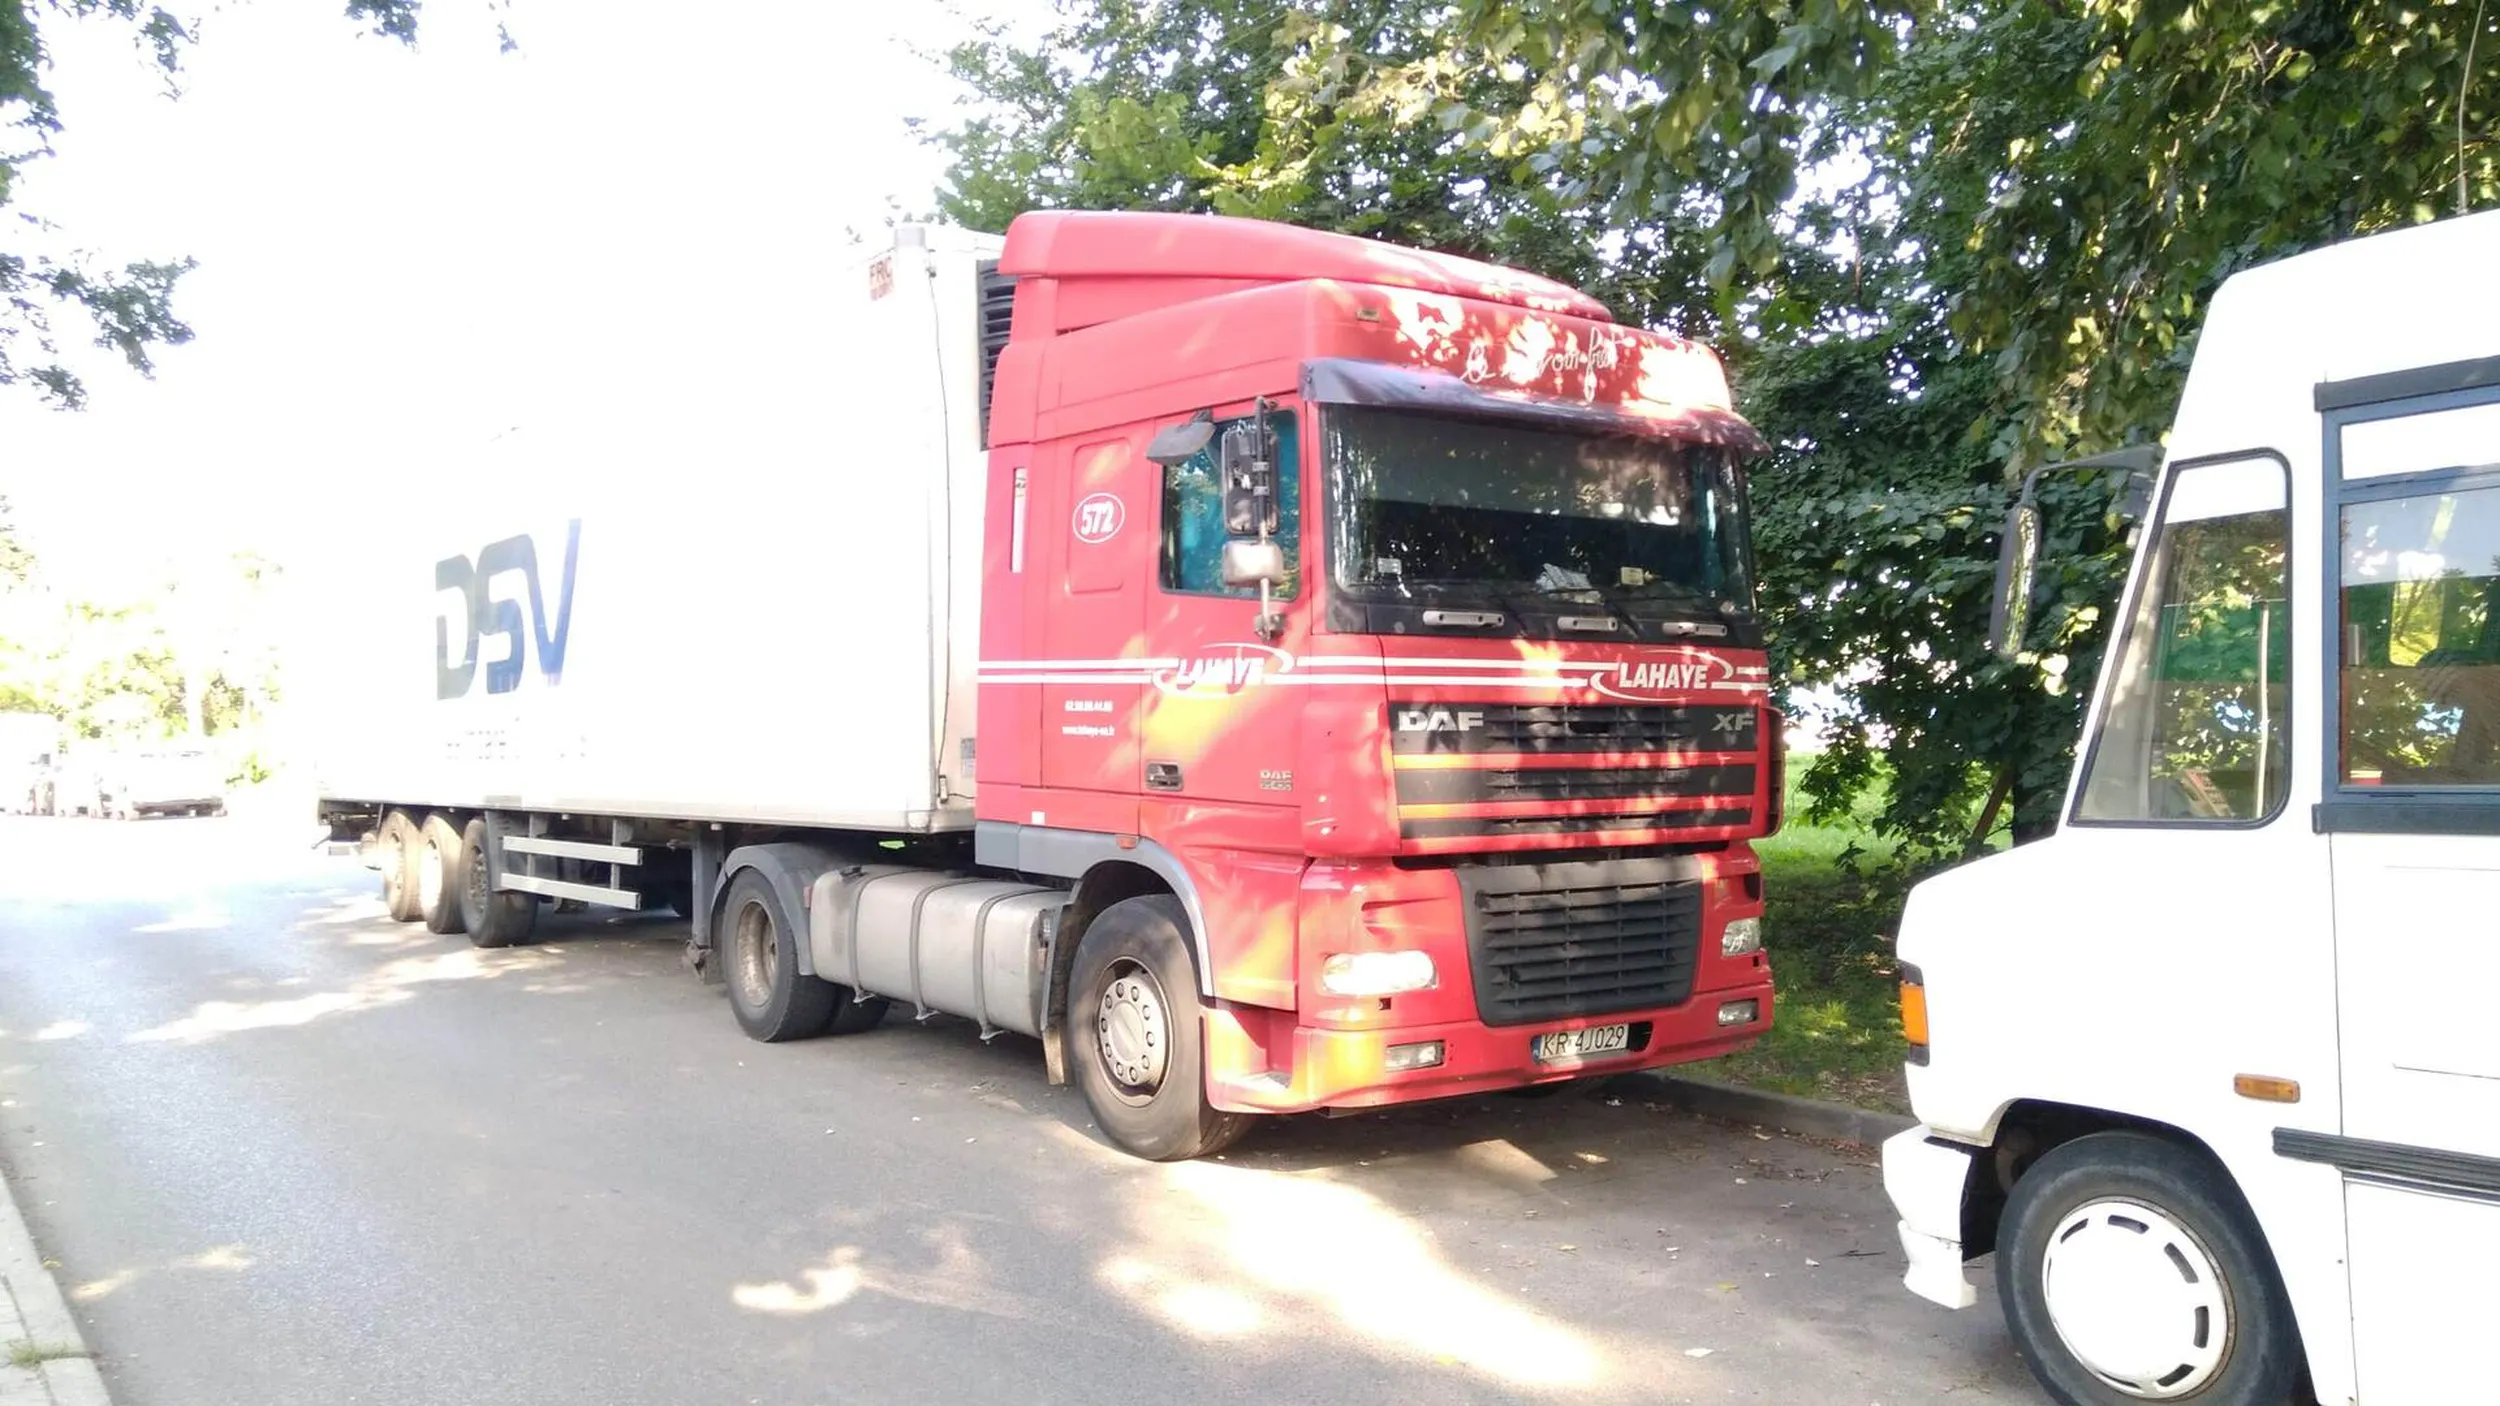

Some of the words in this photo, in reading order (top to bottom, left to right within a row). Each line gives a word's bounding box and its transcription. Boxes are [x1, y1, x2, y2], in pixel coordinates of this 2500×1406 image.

[1080, 500, 1115, 536] 572
[434, 517, 582, 700] DSV
[1618, 661, 1709, 690] LAHAYE
[1398, 710, 1485, 732] DAF
[1711, 712, 1754, 732] XF
[1259, 770, 1293, 780] DAF
[1542, 1031, 1569, 1056] KR
[1574, 1025, 1625, 1051] 4J029
